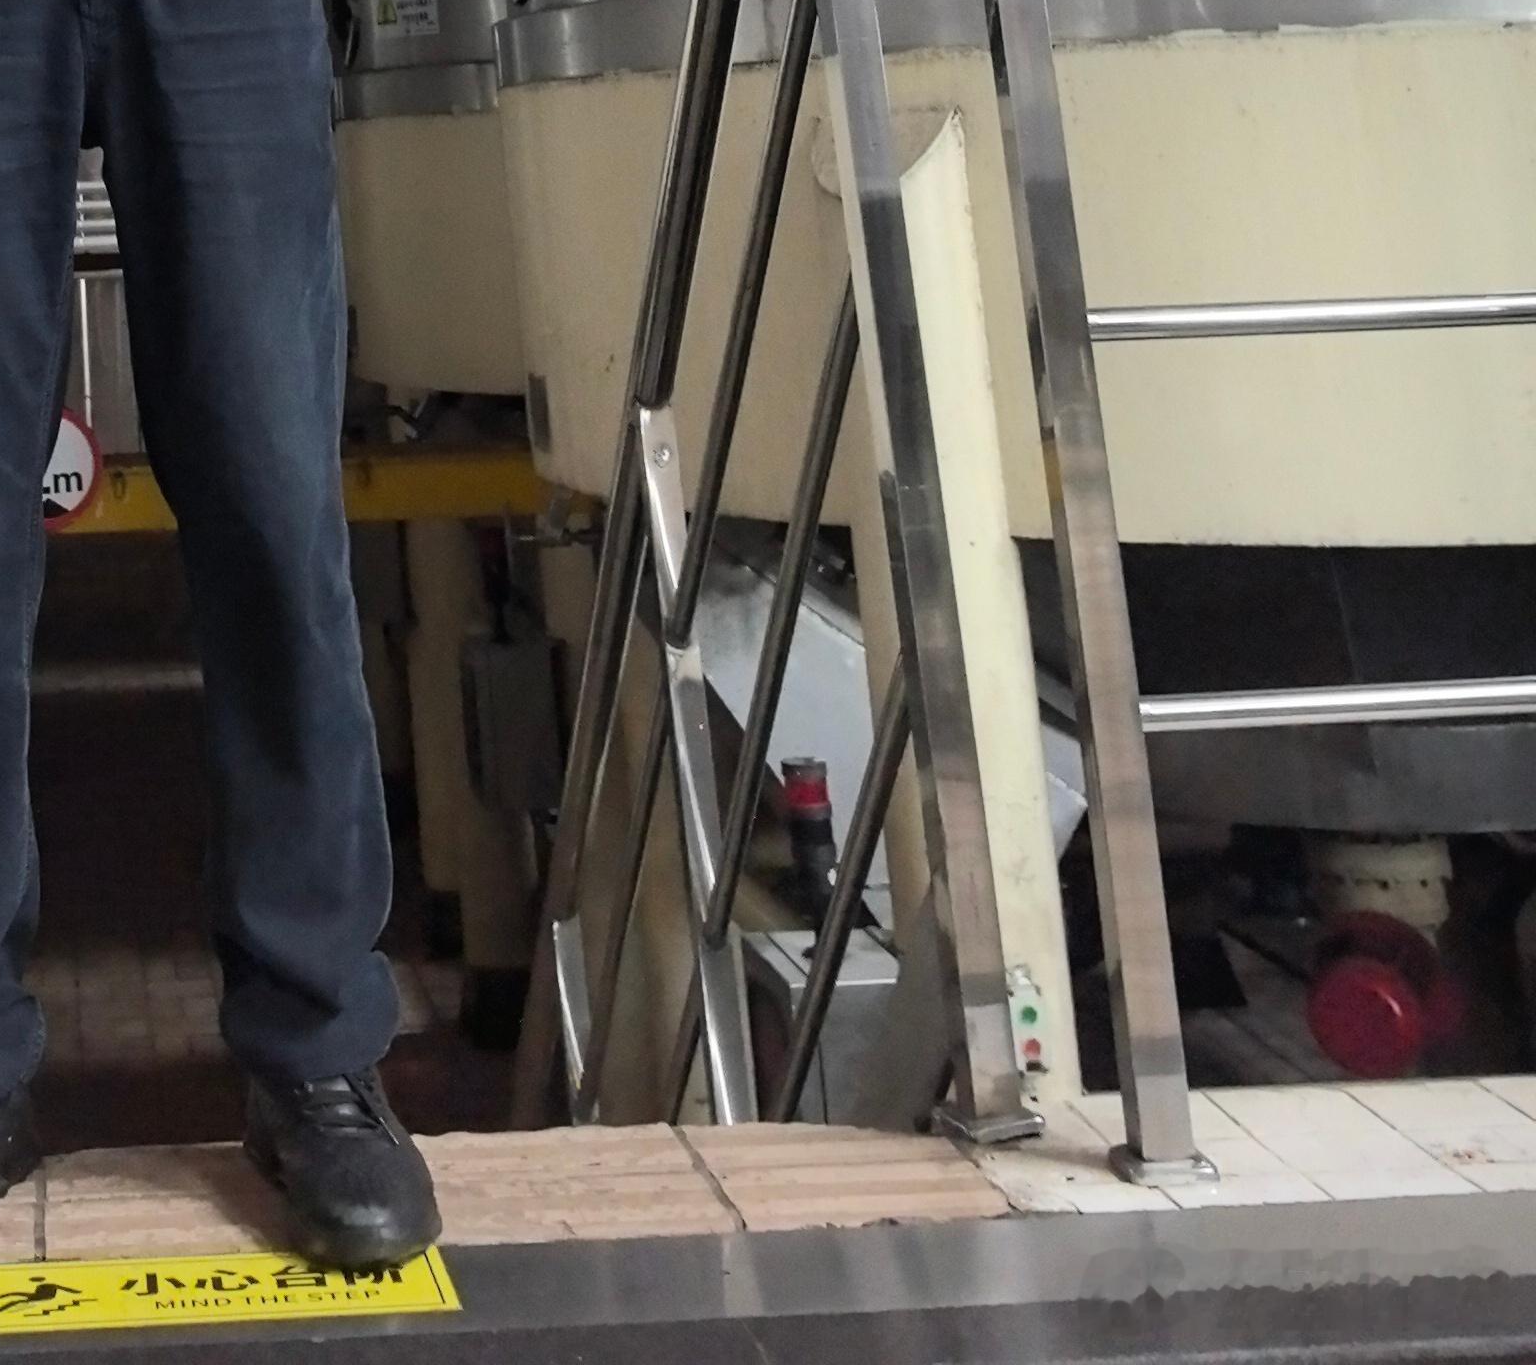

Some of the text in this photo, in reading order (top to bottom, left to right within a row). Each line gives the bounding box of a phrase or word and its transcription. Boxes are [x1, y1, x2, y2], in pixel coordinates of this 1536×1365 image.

[155, 1289, 381, 1310] MIND THE STEP
